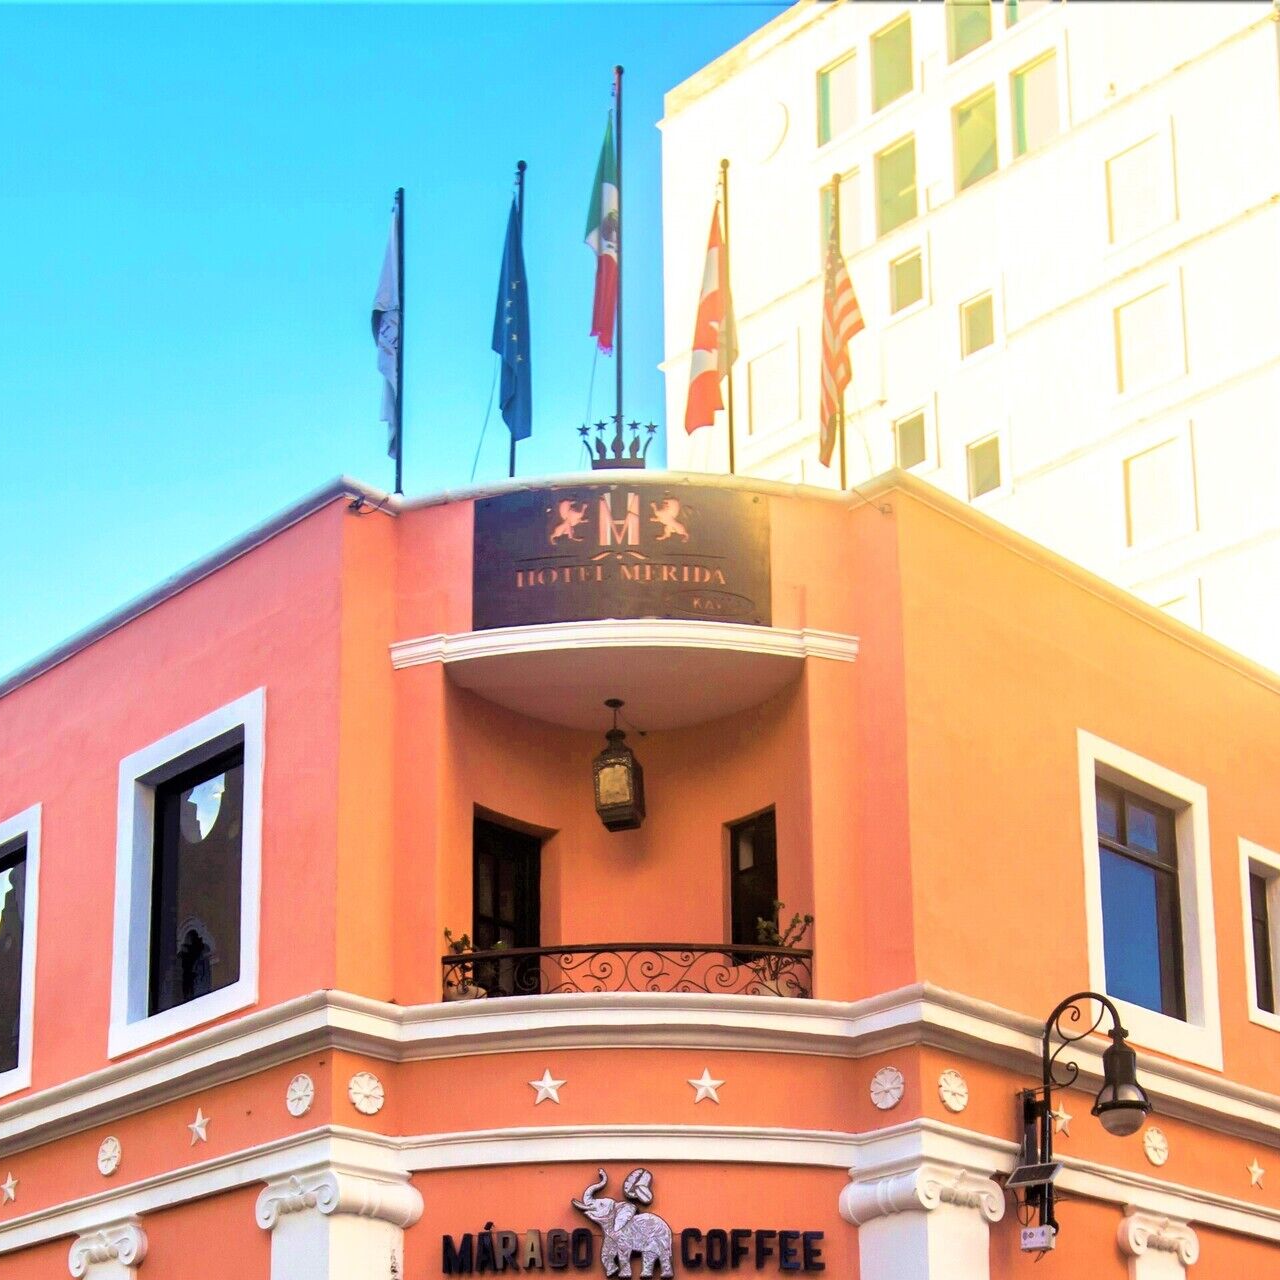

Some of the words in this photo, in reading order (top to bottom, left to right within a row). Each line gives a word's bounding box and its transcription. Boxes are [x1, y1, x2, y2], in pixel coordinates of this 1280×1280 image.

[516, 565, 607, 588] HOTEL
[620, 564, 726, 585] MERIDA
[442, 1221, 594, 1275] MÁRAGO
[681, 1227, 826, 1273] COFFEE
